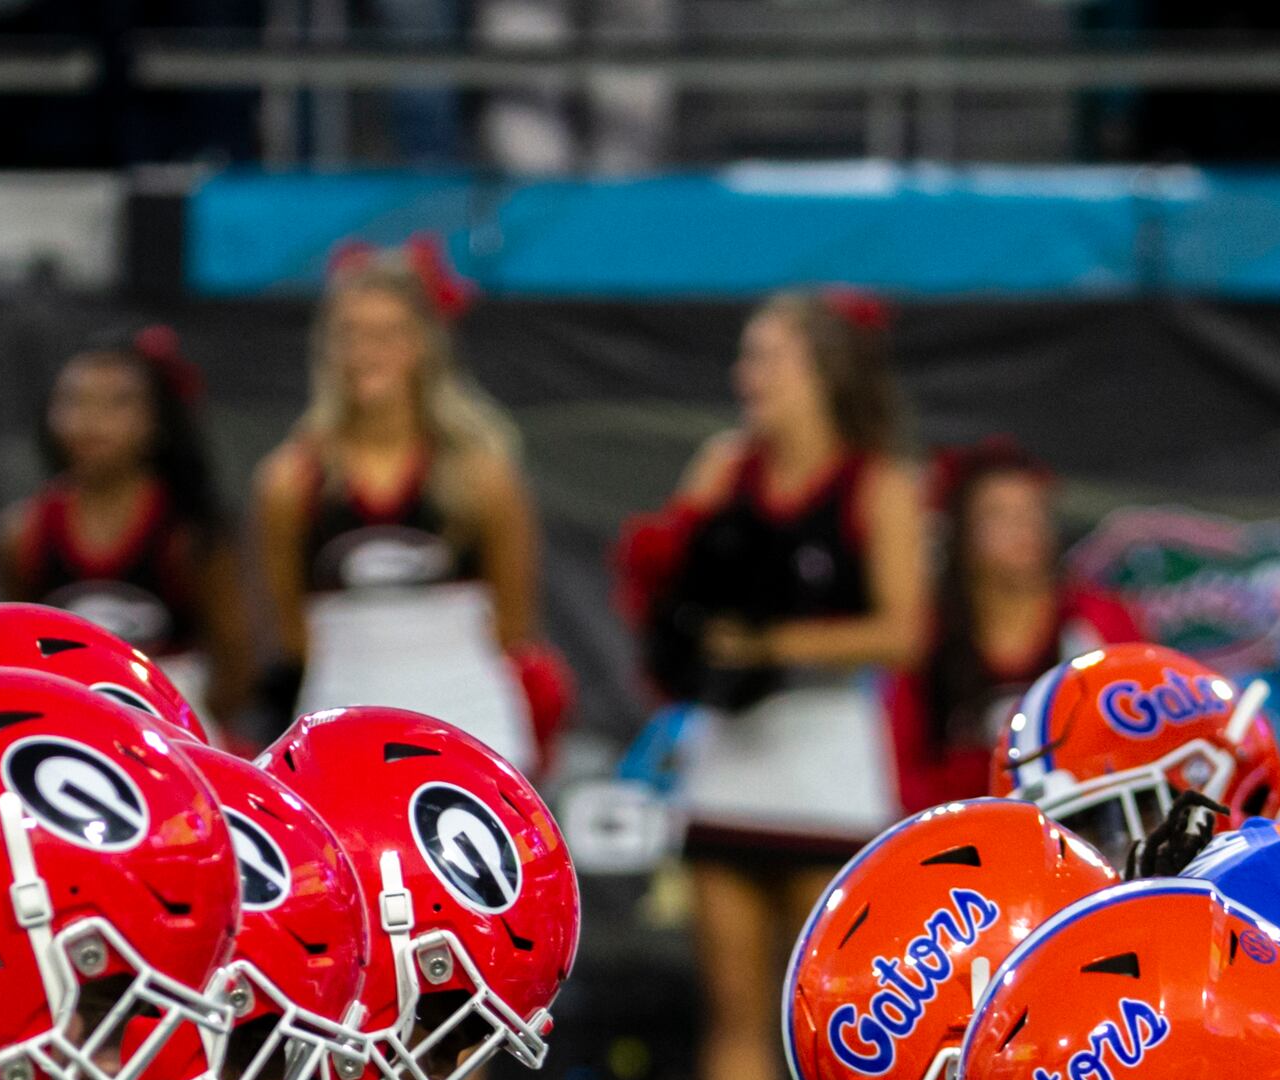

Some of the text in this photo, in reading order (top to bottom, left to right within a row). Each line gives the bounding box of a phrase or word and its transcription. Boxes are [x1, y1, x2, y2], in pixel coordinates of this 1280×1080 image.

[26, 750, 150, 836] G
[431, 803, 521, 910] G
[827, 887, 998, 1077] Gators
